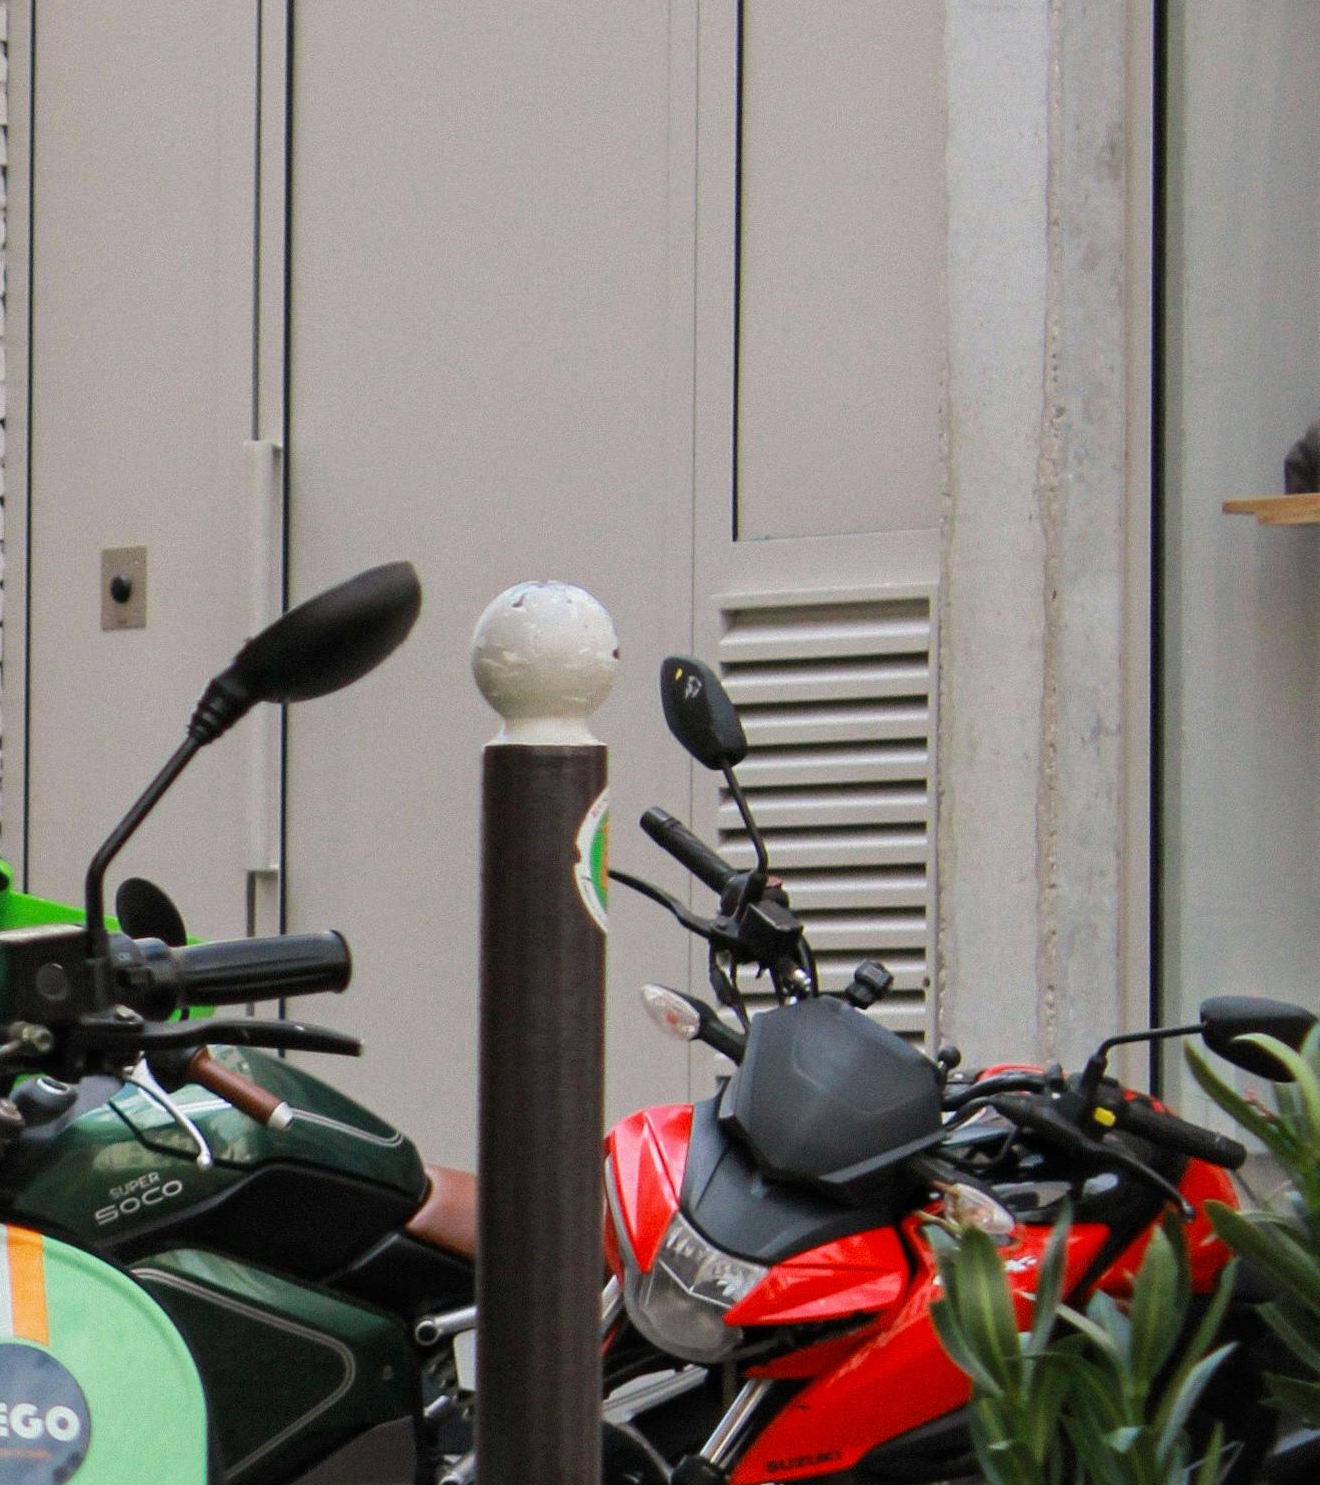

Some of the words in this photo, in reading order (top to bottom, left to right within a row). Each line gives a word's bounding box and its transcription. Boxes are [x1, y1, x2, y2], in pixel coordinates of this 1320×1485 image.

[109, 1171, 160, 1199] SUPER
[95, 1180, 183, 1225] SOCO
[764, 1450, 842, 1473] SUZUKI
